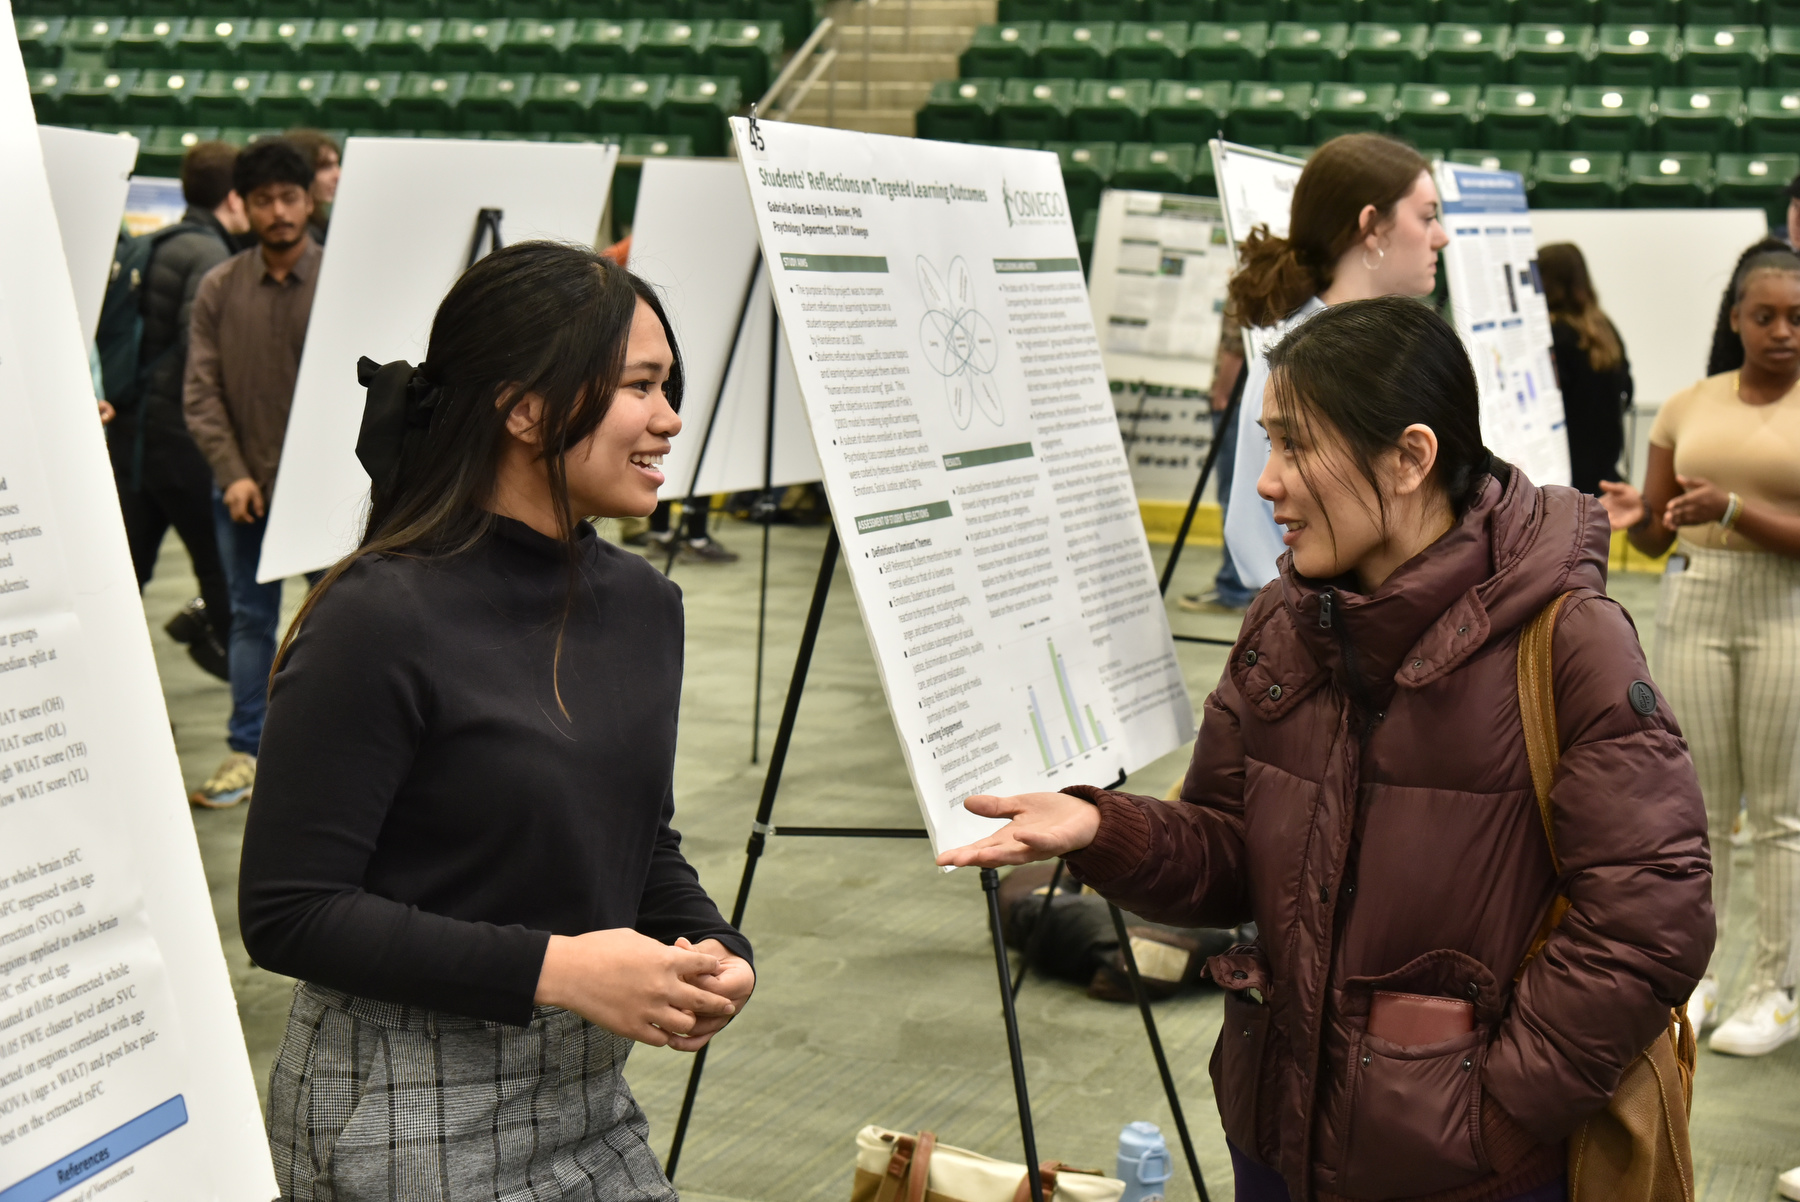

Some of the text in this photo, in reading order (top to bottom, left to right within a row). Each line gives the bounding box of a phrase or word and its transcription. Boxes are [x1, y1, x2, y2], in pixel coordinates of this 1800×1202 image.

[750, 124, 765, 151] 45
[758, 167, 987, 204] Students' Reflections on Targeted Learning Outcomes
[767, 201, 792, 214] Gabrielle
[792, 203, 806, 214] Dion
[806, 204, 811, 215] &
[811, 204, 827, 218] Emily
[827, 205, 833, 216] R.
[852, 207, 862, 218] PhD
[1014, 190, 1065, 218] OSWEGO
[773, 221, 869, 239] Psychology Department, SUNY Oswego
[9, 629, 38, 648] groups
[28, 649, 47, 668] split
[48, 648, 57, 660] at
[19, 705, 41, 720] score
[42, 696, 65, 717] (OH)
[22, 731, 44, 746] score
[45, 722, 67, 742] (OL)
[14, 755, 40, 774] WIAT
[42, 751, 65, 767] score
[65, 742, 87, 762] (YH)
[16, 781, 45, 801] WIAT
[46, 777, 67, 792] score
[68, 767, 89, 788] (YL)
[11, 866, 38, 885] whole
[37, 857, 63, 876] brain
[63, 847, 83, 867] rsFC
[18, 883, 60, 911] regressed
[60, 876, 80, 893] with
[80, 873, 95, 889] age
[36, 909, 66, 934] (SVC)
[66, 901, 86, 918] with
[29, 937, 61, 964] applied
[61, 937, 71, 948] to
[72, 923, 97, 944] whole
[97, 914, 119, 934] brain
[15, 974, 37, 995] rsFC
[38, 966, 55, 984] and
[55, 963, 71, 979] age
[26, 1005, 34, 1019] at
[34, 994, 54, 1015] 0.05
[56, 972, 105, 1005] uncorrected
[104, 962, 130, 983] whole
[20, 1026, 44, 1050] FWE
[45, 1016, 74, 1038] cluster
[73, 1003, 95, 1025] level
[96, 997, 116, 1015] after
[116, 984, 137, 1005] SVC
[24, 1062, 36, 1076] on
[37, 1048, 68, 1070] regions
[69, 1022, 110, 1054] correlated
[111, 1015, 130, 1033] with
[131, 1010, 145, 1027] age
[30, 1084, 50, 1104] (age
[51, 1080, 58, 1091] x
[57, 1061, 89, 1087] WIAT)
[89, 1052, 106, 1072] and
[105, 1046, 123, 1067] post
[123, 1038, 139, 1056] hoc
[140, 1028, 159, 1050] pair-
[17, 1123, 30, 1138] on
[30, 1115, 45, 1130] the
[46, 1091, 84, 1122] extracted
[84, 1080, 106, 1103] rsFC
[57, 1147, 111, 1186] References
